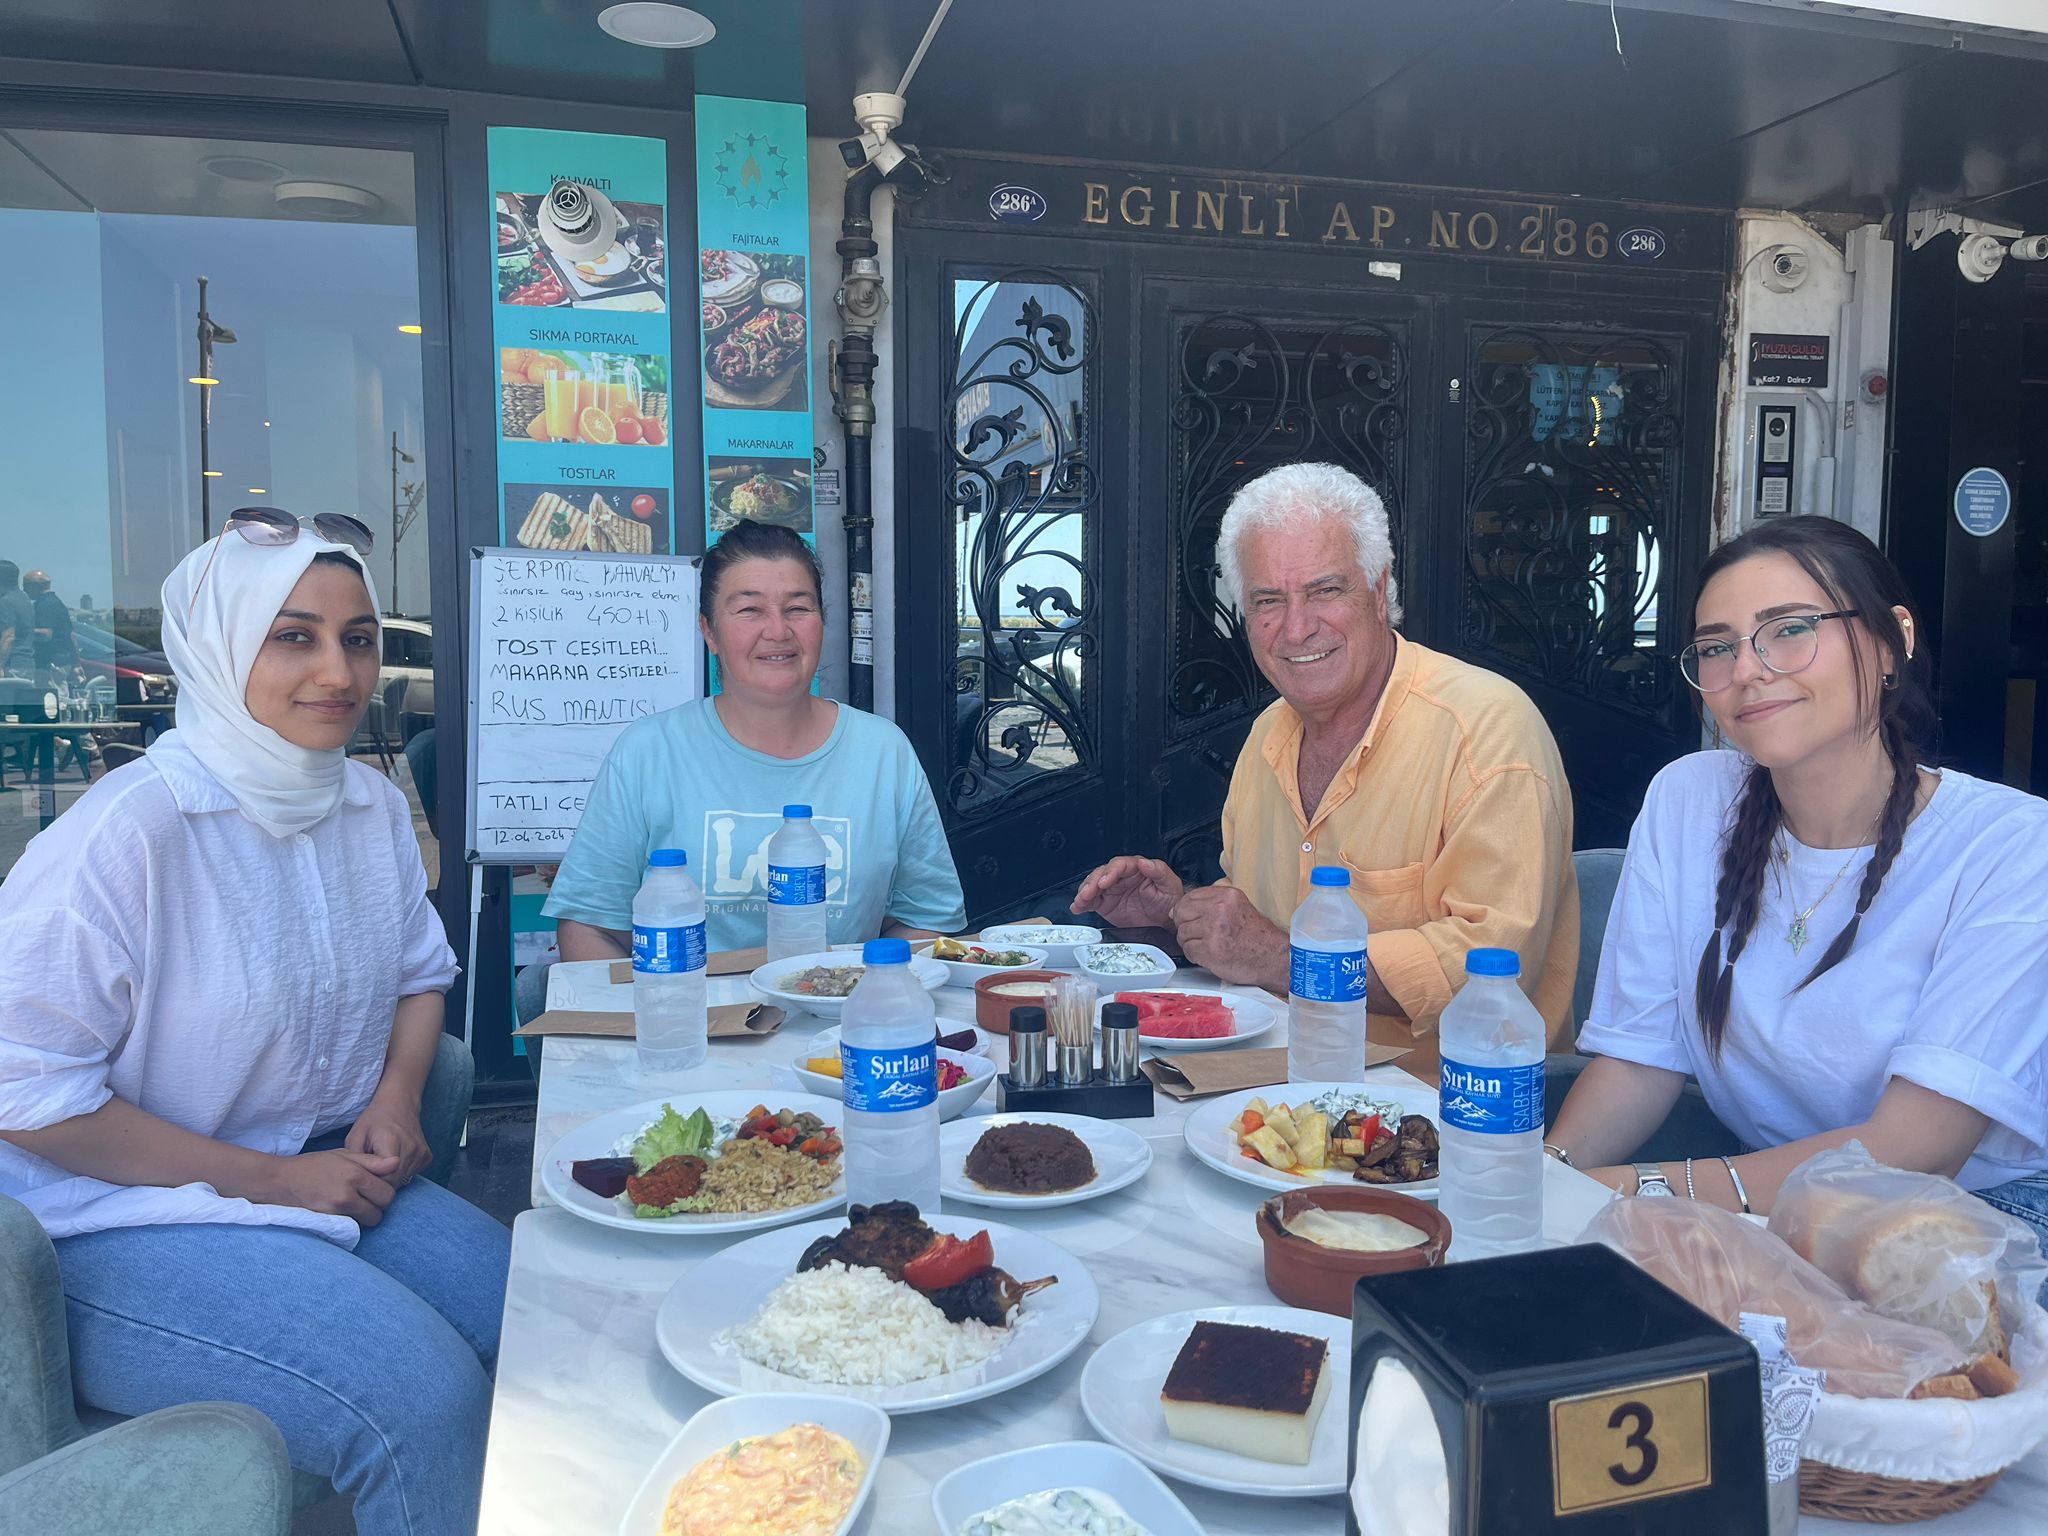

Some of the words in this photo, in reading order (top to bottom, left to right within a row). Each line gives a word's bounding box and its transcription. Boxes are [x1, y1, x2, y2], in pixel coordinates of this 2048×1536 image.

[550, 174, 611, 190] KHVALTI
[732, 233, 780, 246] FAJİTALAR
[1631, 234, 1655, 251] 286
[529, 328, 571, 342] SIKMA
[574, 332, 638, 346] PORTAKAL
[728, 438, 794, 450] MAKARNALAR
[559, 466, 616, 480] TOSTLAR
[497, 639, 557, 656] TOST
[490, 663, 589, 681] MAKARNA
[492, 690, 546, 721] RUS
[489, 795, 548, 812] TATLI
[558, 795, 585, 813] ÇE
[871, 1054, 929, 1080] Şırlan
[1442, 1063, 1501, 1094] Şırlan
[1607, 1401, 1659, 1487] 3
